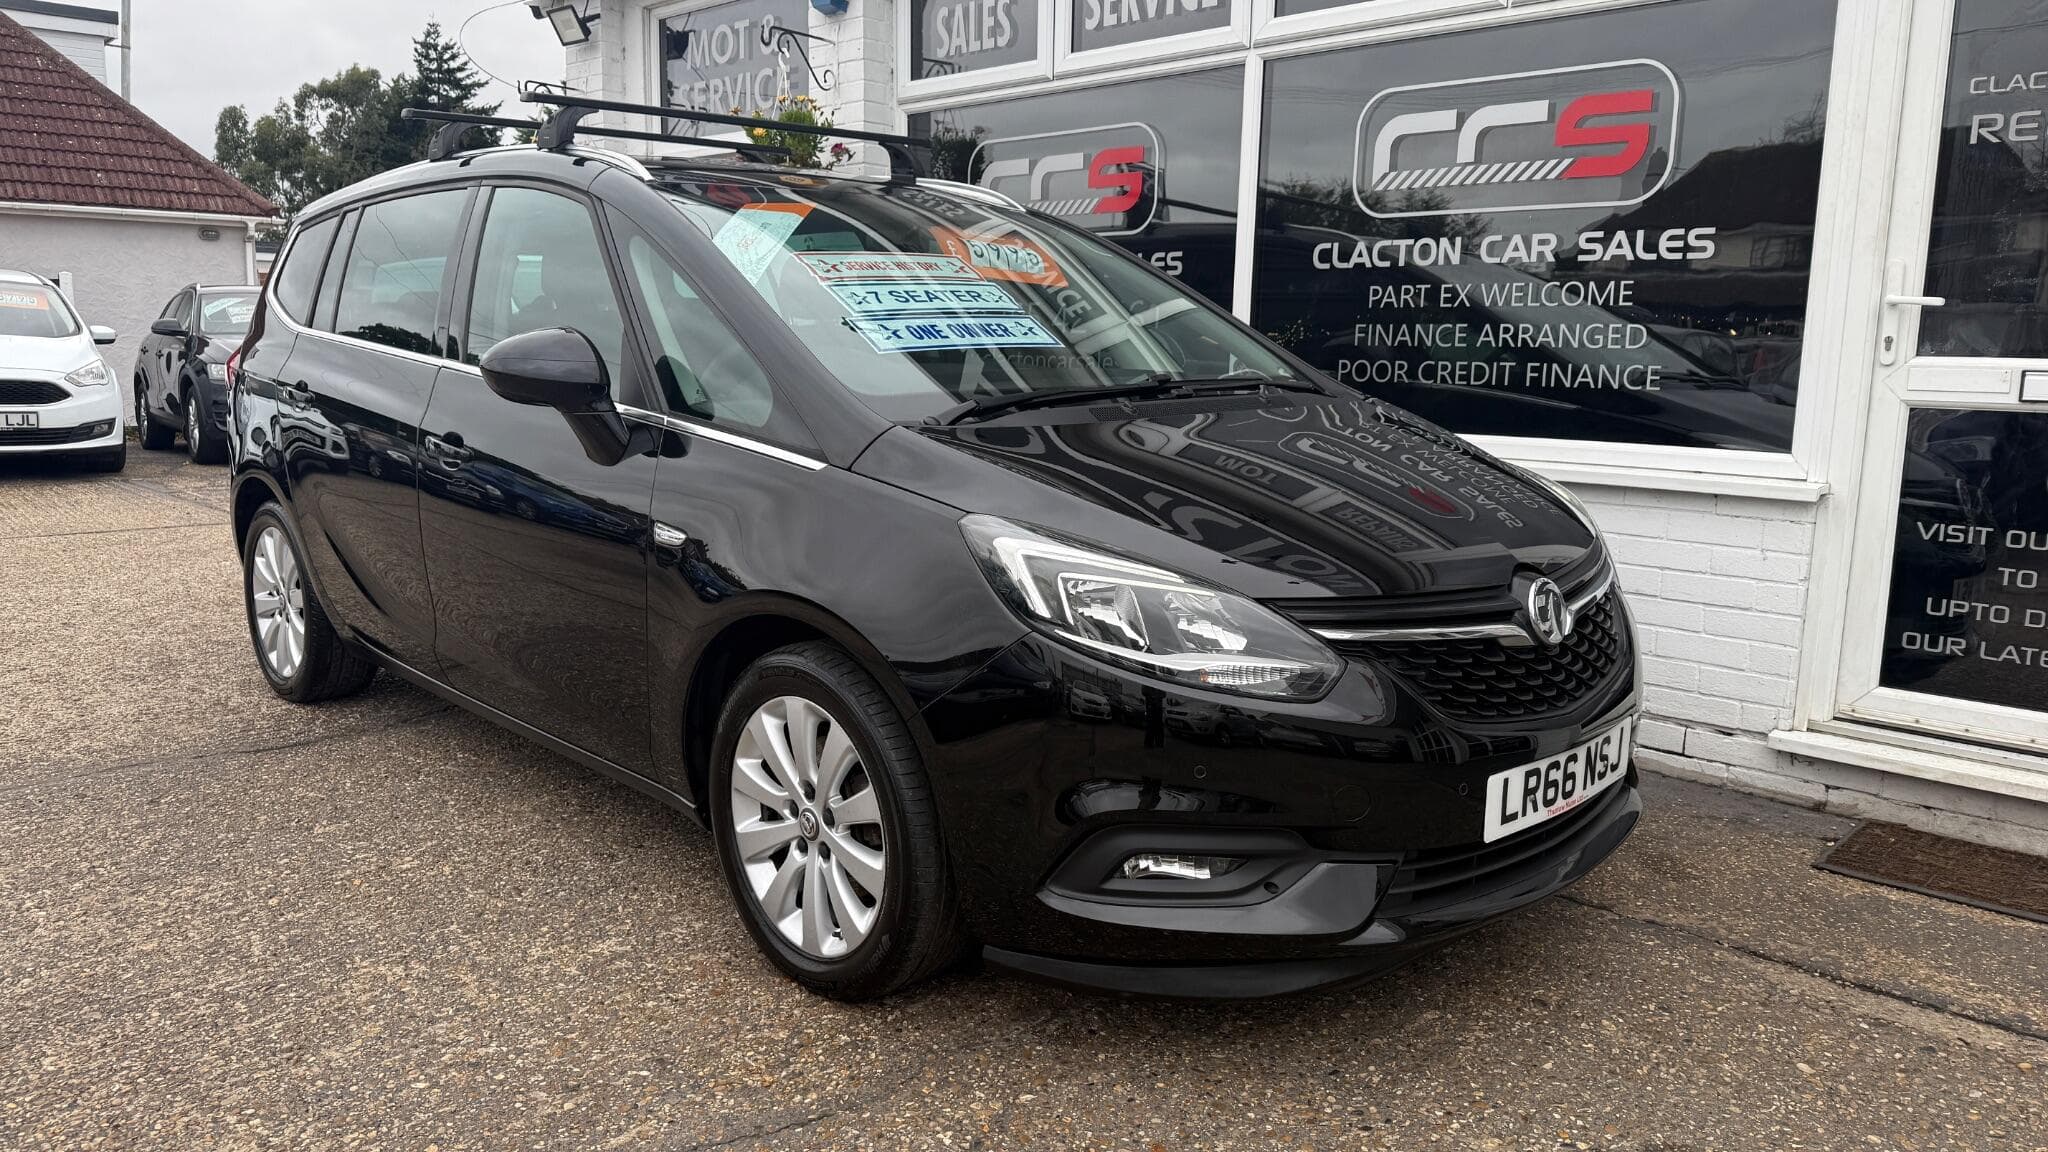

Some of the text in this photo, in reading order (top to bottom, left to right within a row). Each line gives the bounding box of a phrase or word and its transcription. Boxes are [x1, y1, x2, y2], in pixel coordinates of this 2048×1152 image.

[687, 14, 783, 70] MOT &
[936, 0, 1011, 58] SALES
[675, 66, 791, 112] SERVICE
[1969, 110, 2048, 144] RE
[1313, 227, 1716, 269] CLACTON CAR SALES
[843, 260, 941, 272] SERVICE HISTORY
[865, 289, 990, 304] 7 SEATER
[1369, 281, 1635, 308] PART EX WELCOME
[905, 322, 1016, 341] ONE OWNER
[1354, 323, 1647, 349] FINANCE ARRANGED
[1338, 359, 1662, 390] POOR CREDIT FINANCE
[5, 414, 36, 426] LJL
[1917, 521, 1994, 545] VISIT
[1998, 567, 2038, 589] TO
[1926, 597, 2048, 631] UPTO D
[1901, 631, 1967, 657] OUR
[1500, 727, 1624, 826] LR66 NSJ
